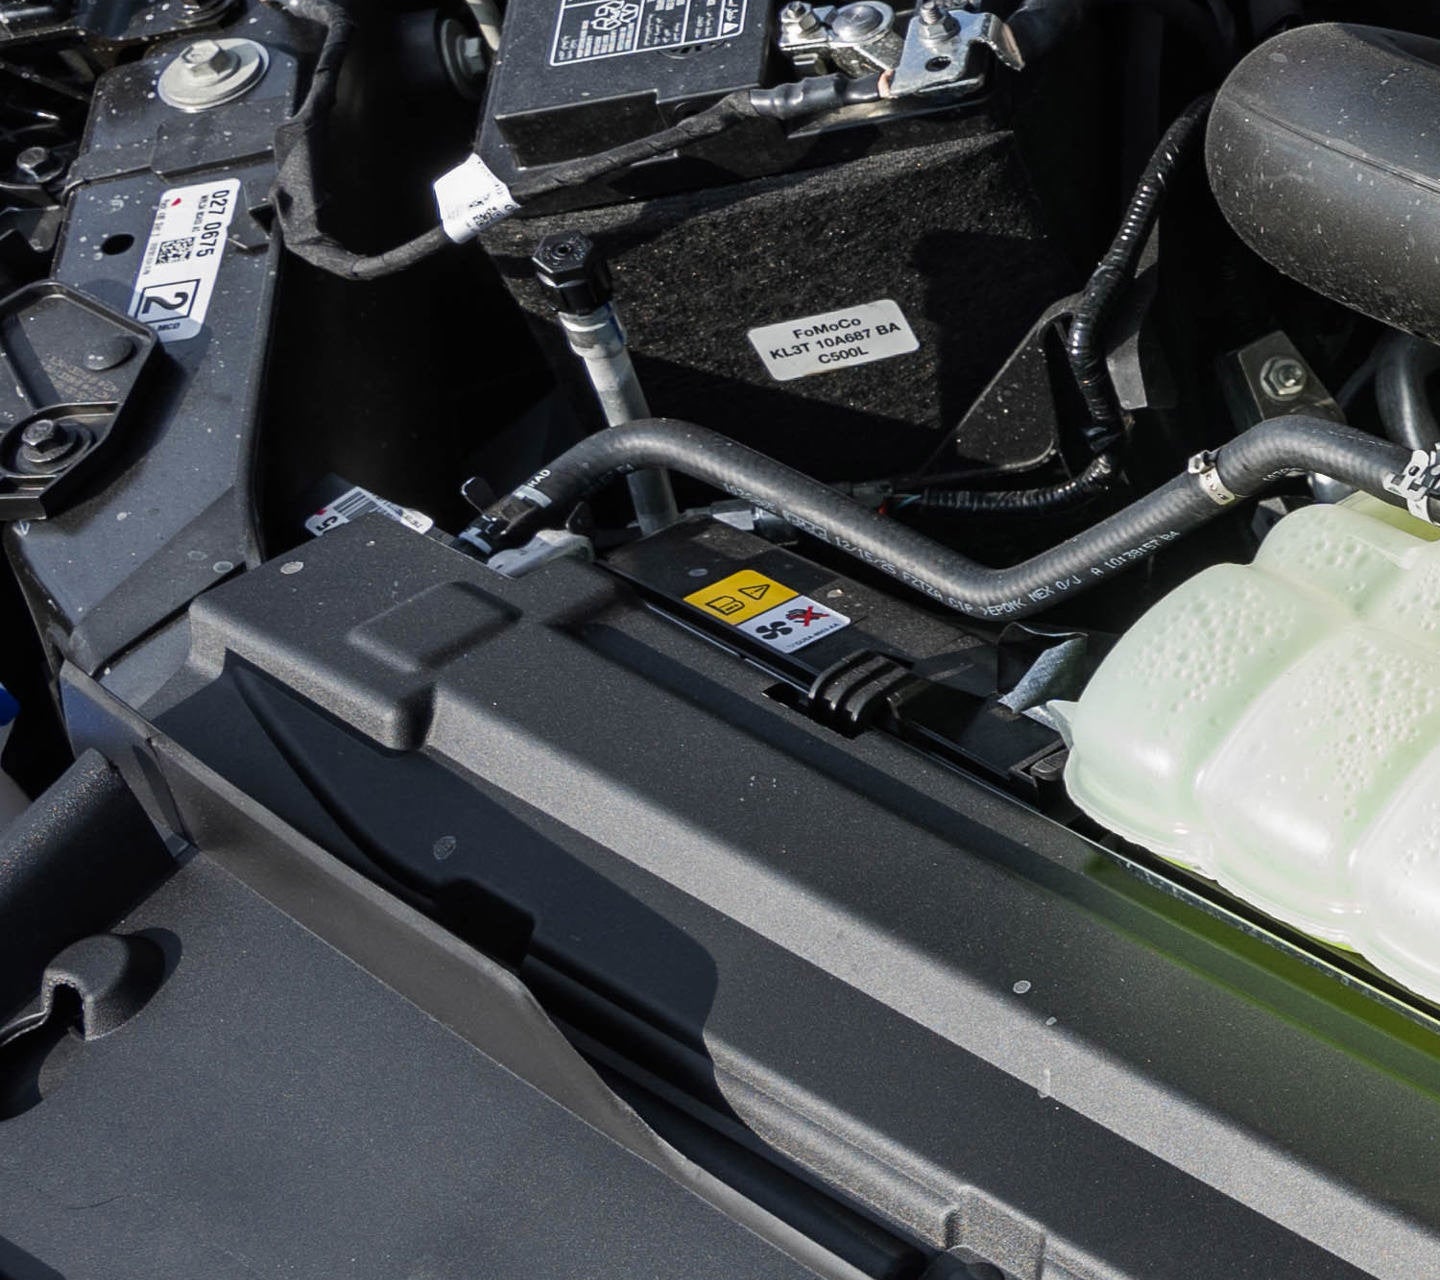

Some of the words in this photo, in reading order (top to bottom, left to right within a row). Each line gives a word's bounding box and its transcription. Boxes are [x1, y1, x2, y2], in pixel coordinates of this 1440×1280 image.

[210, 189, 230, 216] 027
[195, 221, 222, 258] 0675
[141, 291, 189, 315] 2
[792, 317, 863, 340] FoMoCo
[769, 342, 812, 361] KL3T
[816, 328, 872, 350] 10A687
[875, 321, 902, 337] BA
[818, 345, 870, 365] C500L
[1030, 585, 1056, 603] MEX
